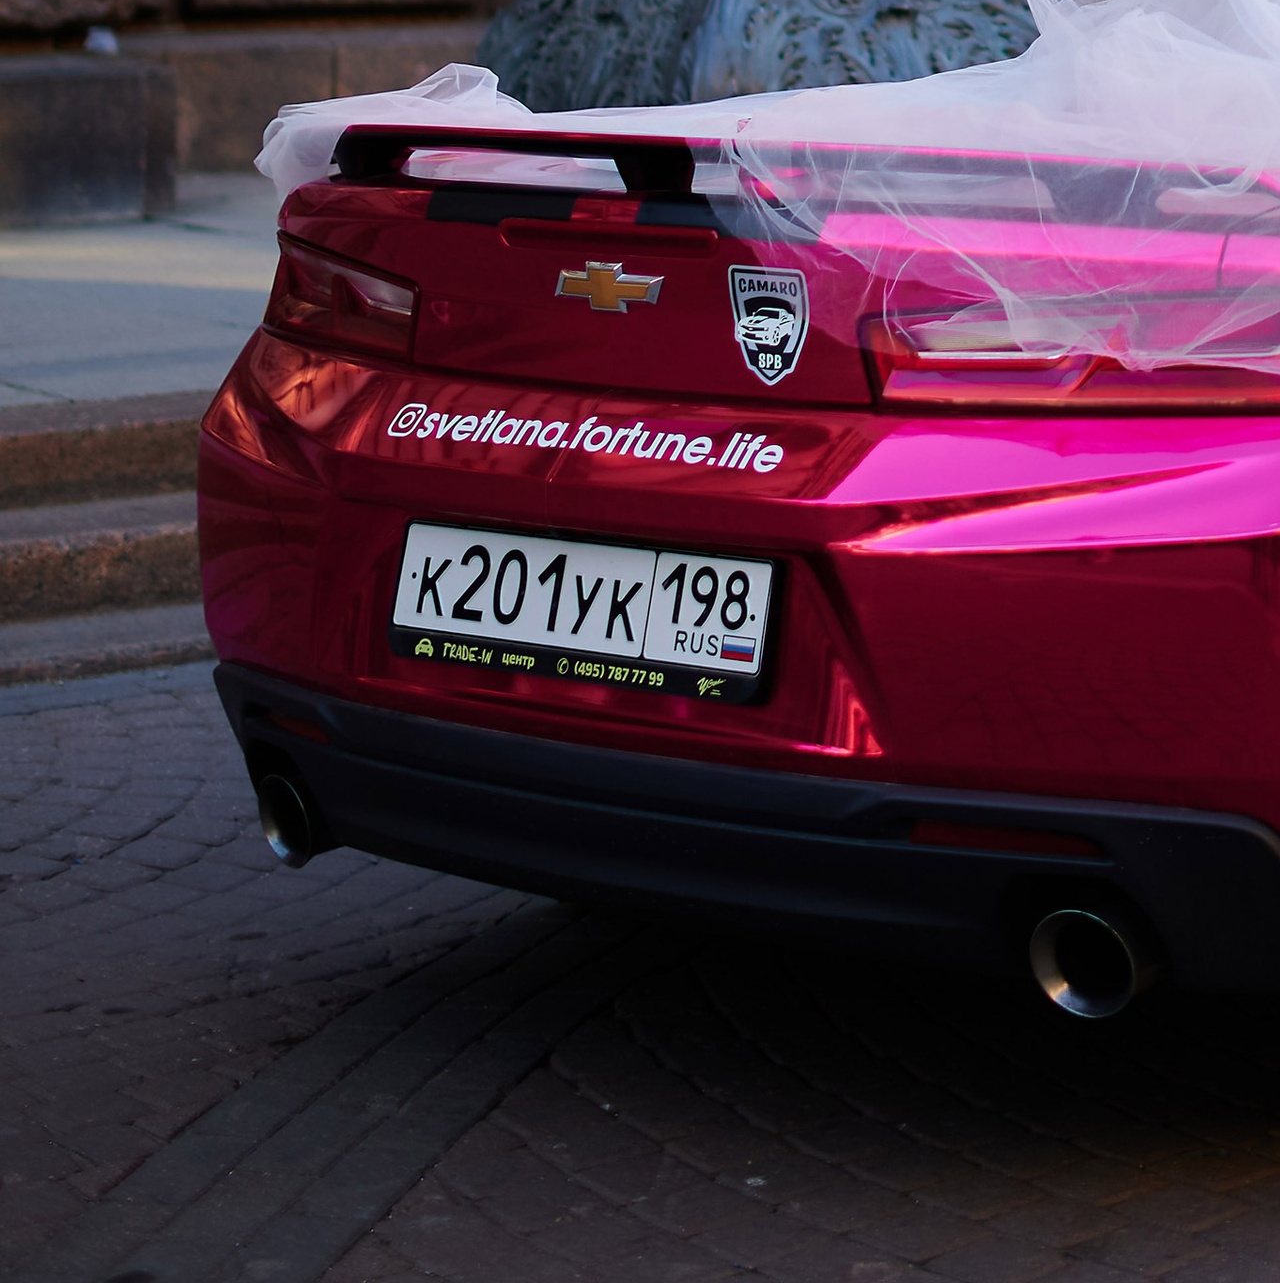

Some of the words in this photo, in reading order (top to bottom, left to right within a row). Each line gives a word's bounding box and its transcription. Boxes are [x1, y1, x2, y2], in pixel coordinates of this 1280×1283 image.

[739, 278, 797, 297] CAMARO
[758, 353, 782, 369] SPB
[417, 409, 784, 473] svetlana.fortune.life
[660, 562, 752, 631] 198
[443, 642, 494, 665] TRADE-IN
[501, 653, 535, 670] центр
[673, 630, 719, 657] RUS
[574, 660, 605, 679] (495)
[607, 666, 630, 681] 787
[631, 669, 647, 684] 77
[648, 671, 664, 686] 99
